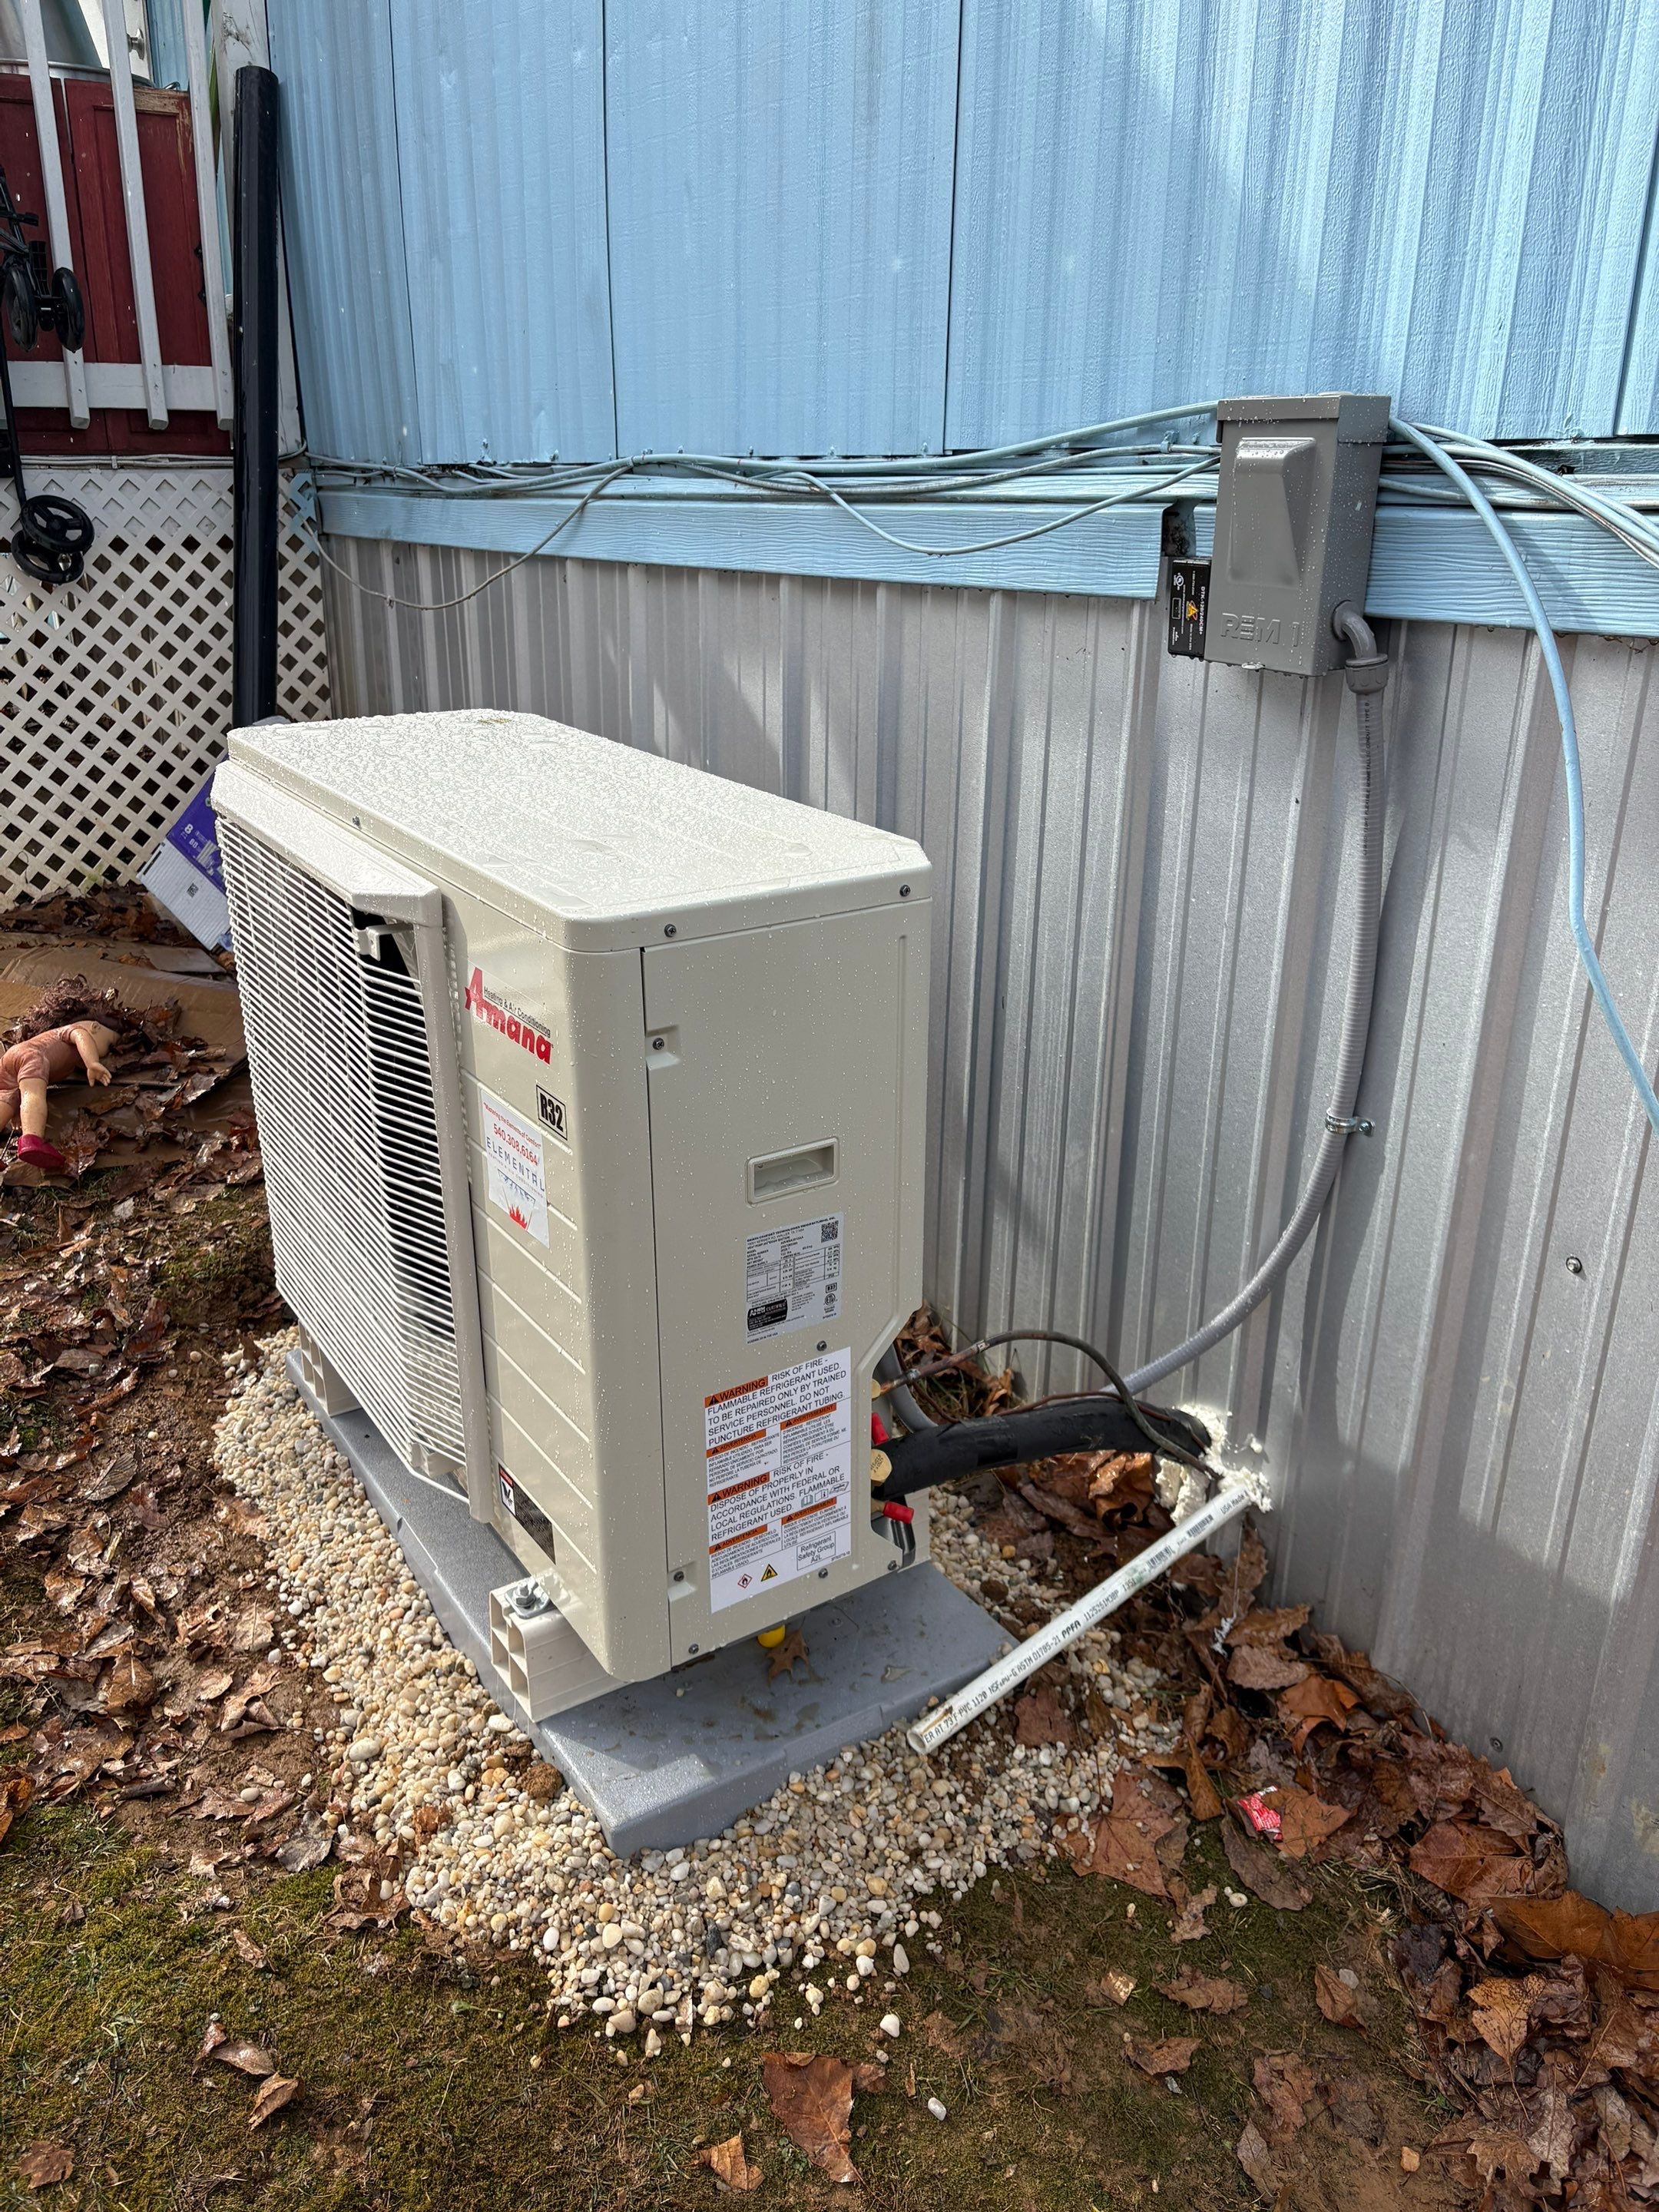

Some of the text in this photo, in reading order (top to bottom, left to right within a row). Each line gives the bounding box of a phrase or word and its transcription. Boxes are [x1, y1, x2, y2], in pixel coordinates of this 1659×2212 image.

[1220, 613, 1281, 645] REM
[464, 966, 551, 1065] Amana
[484, 986, 503, 1007] Heating
[517, 1007, 551, 1038] Conditioning
[539, 1092, 565, 1133] R32
[485, 1135, 545, 1193] ELEMENTAL
[707, 1361, 841, 1416] FLAMMABLE REFRIGERANT USED.
[707, 1369, 846, 1426] TO BE REPAIRED ONLY BY TRAINED
[720, 1377, 765, 1402] WARNING
[771, 1369, 790, 1383] RISK
[792, 1364, 803, 1376] OF
[805, 1357, 823, 1372] FIRE
[708, 1385, 830, 1436] SERVICE PERSONNEL. DO NOT
[708, 1389, 845, 1447] PUNCTURE REFRIGERANT TUBING.
[710, 1465, 813, 1512] DISPOSE OF PROPERLY IN
[710, 1465, 839, 1522] ACCORDANCE WITH FEDERAL OR
[722, 1473, 767, 1498] WARNING
[773, 1463, 792, 1479] RISK
[793, 1459, 804, 1471] OF
[806, 1452, 823, 1465] FIRE
[710, 1472, 844, 1532] LOCAL REGULATIONS. FLAMMABLE
[711, 1502, 793, 1541] REFRIGERANT USED.
[797, 1548, 816, 1562] Safety
[816, 1540, 834, 1555] Group
[800, 1534, 831, 1554] Refrigerant
[810, 1552, 822, 1564] A2L
[922, 1730, 936, 1743] ER
[932, 1724, 945, 1736] AT
[956, 1701, 973, 1717] PVC
[969, 1690, 989, 1707] 1120
[1014, 1654, 1035, 1674] ASTM
[1059, 1618, 1082, 1639] PPFA
